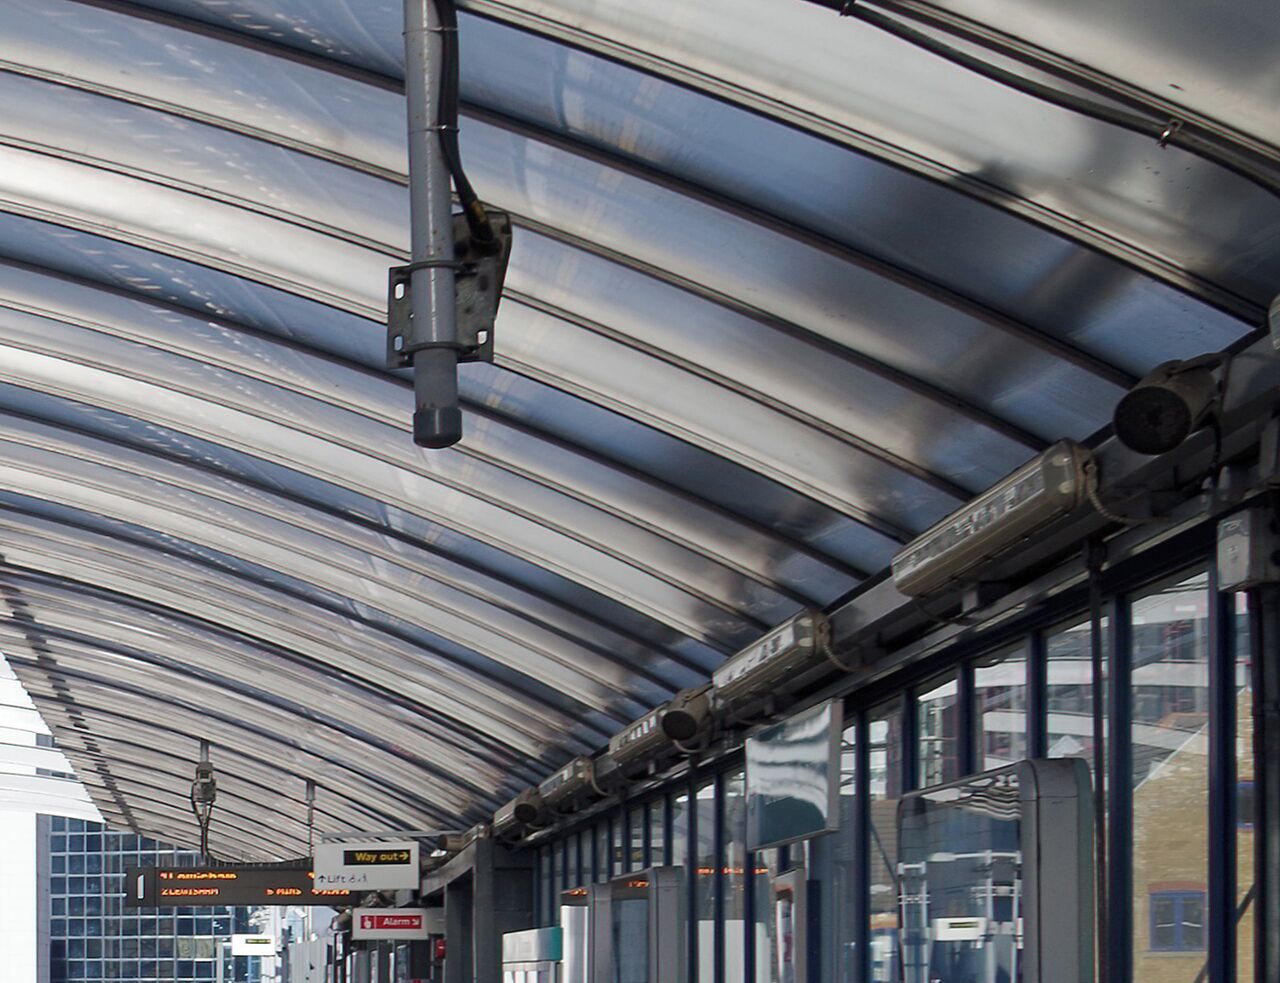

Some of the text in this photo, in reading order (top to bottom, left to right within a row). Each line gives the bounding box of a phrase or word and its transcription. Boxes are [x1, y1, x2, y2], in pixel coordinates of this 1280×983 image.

[354, 851, 400, 863] Way out
[327, 874, 346, 884] Lift
[382, 917, 410, 926] Alarm
